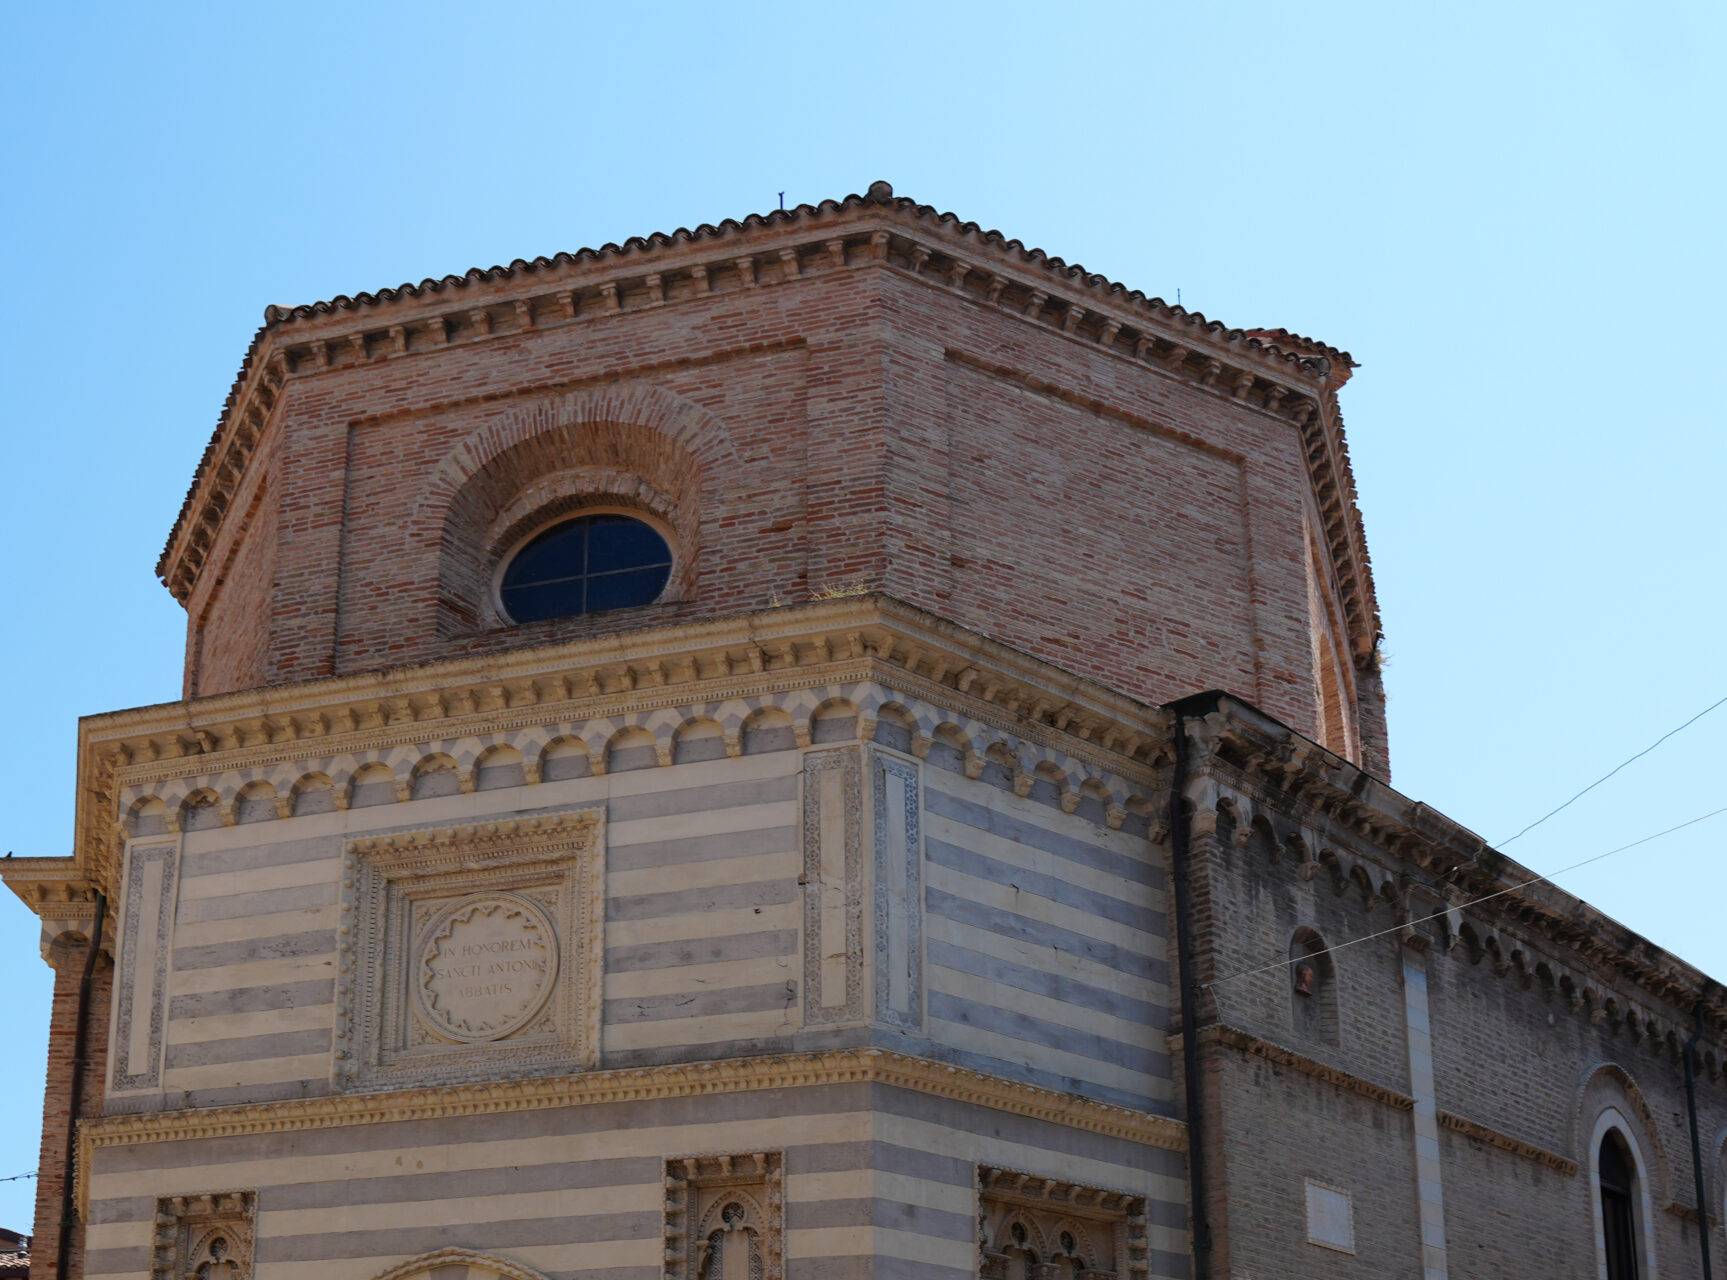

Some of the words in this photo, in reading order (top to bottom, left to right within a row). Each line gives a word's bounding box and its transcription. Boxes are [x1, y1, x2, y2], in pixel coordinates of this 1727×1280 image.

[444, 946, 456, 959] IN
[463, 938, 531, 956] HONOREM
[437, 965, 481, 979] SANCTI
[458, 983, 513, 998] ABBATIS
